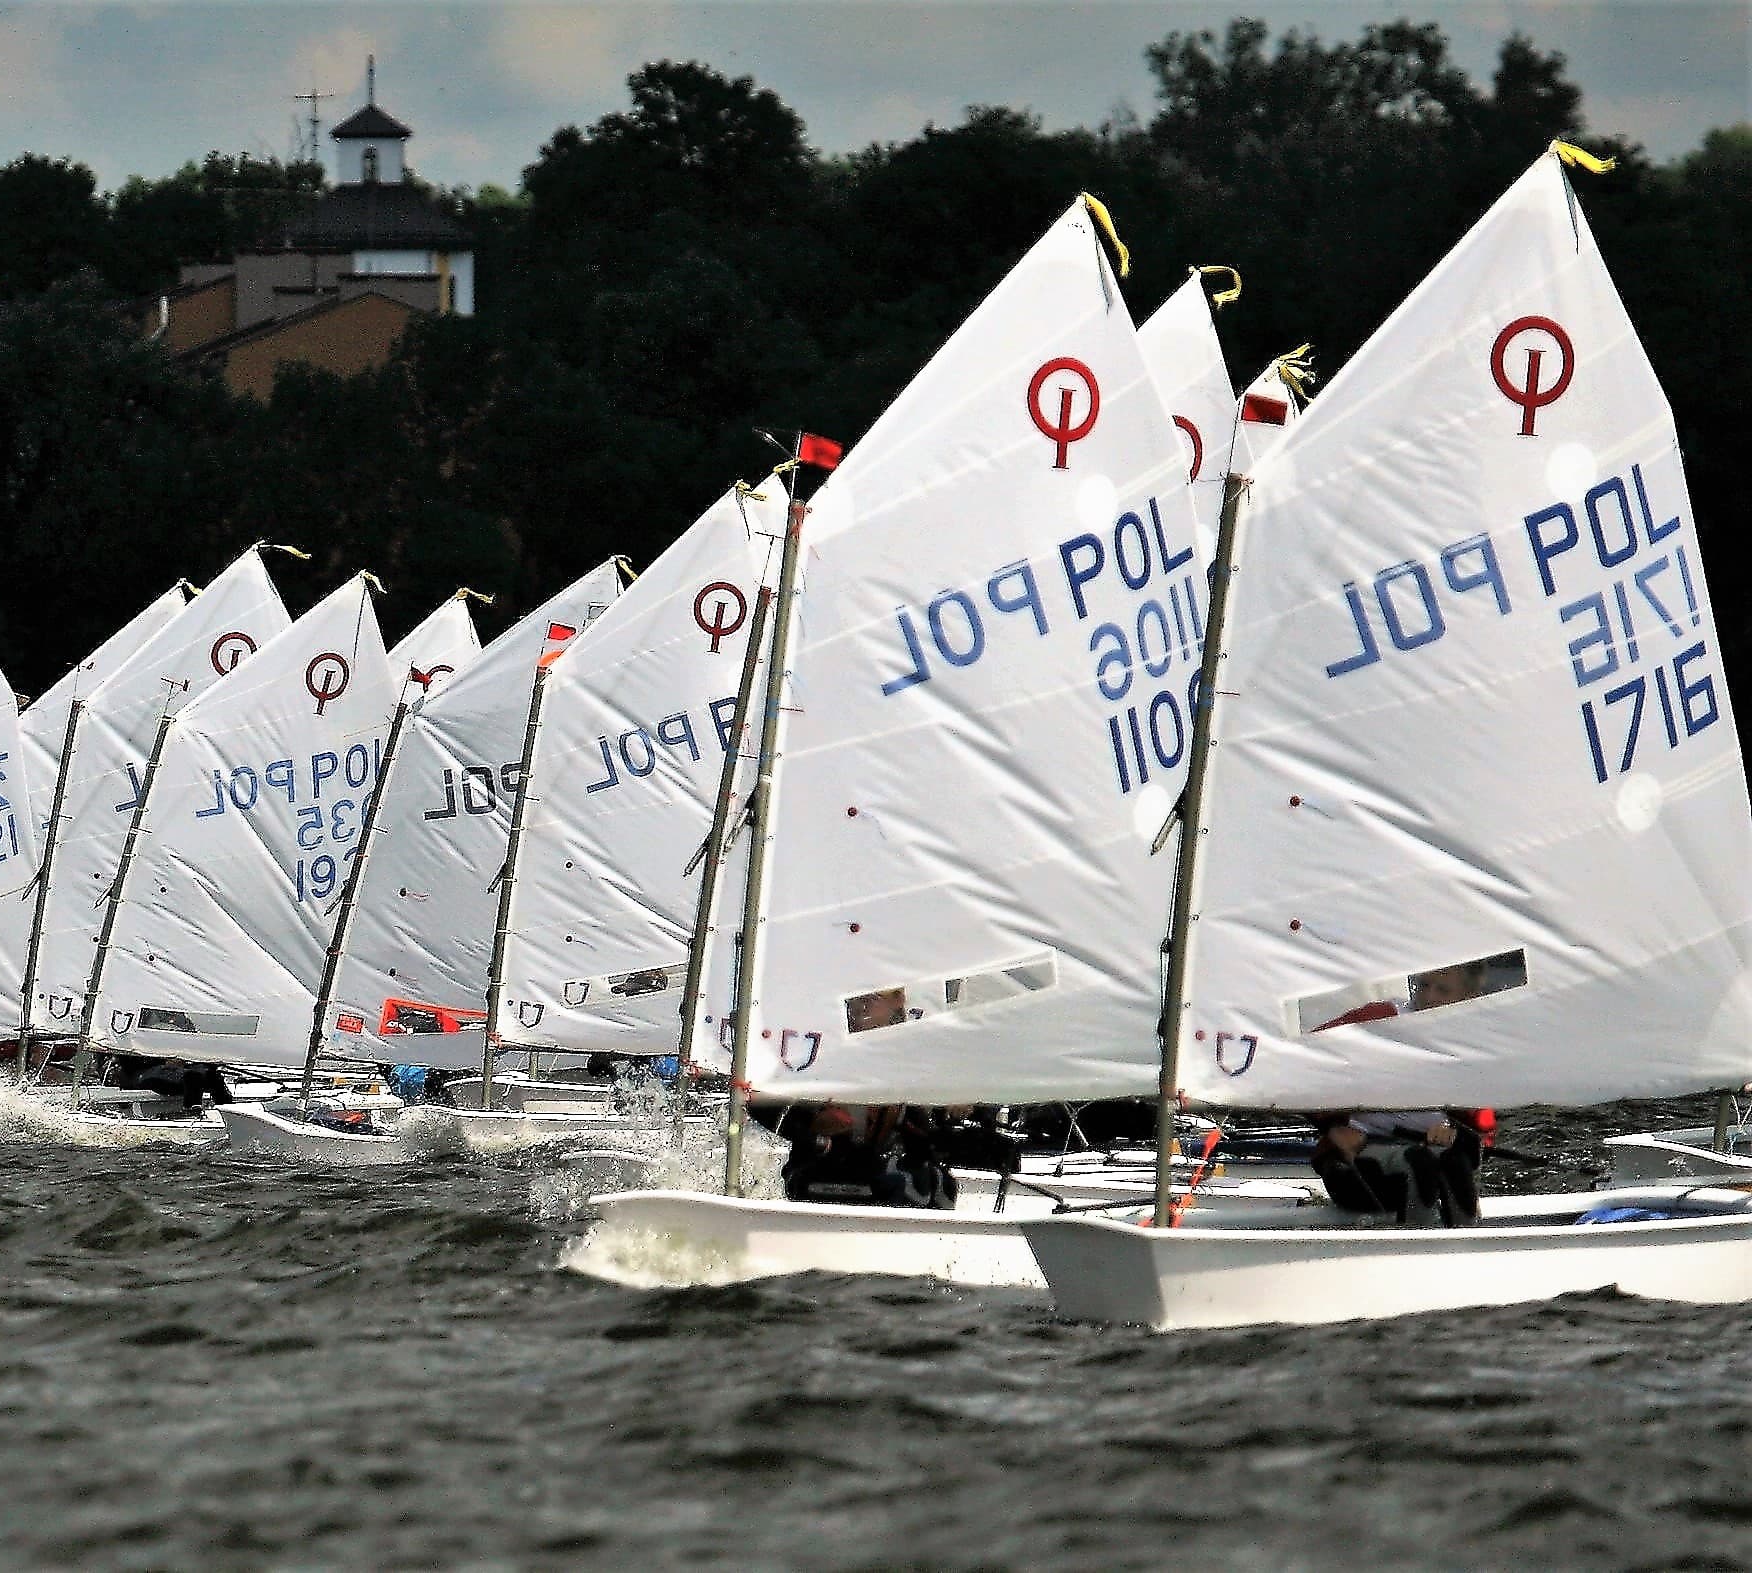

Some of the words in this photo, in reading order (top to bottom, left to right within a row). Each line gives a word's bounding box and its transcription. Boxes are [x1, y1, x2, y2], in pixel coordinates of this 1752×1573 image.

[1059, 496, 1195, 619] POL
[1524, 464, 1681, 597] POL
[1580, 640, 1720, 784] 1716
